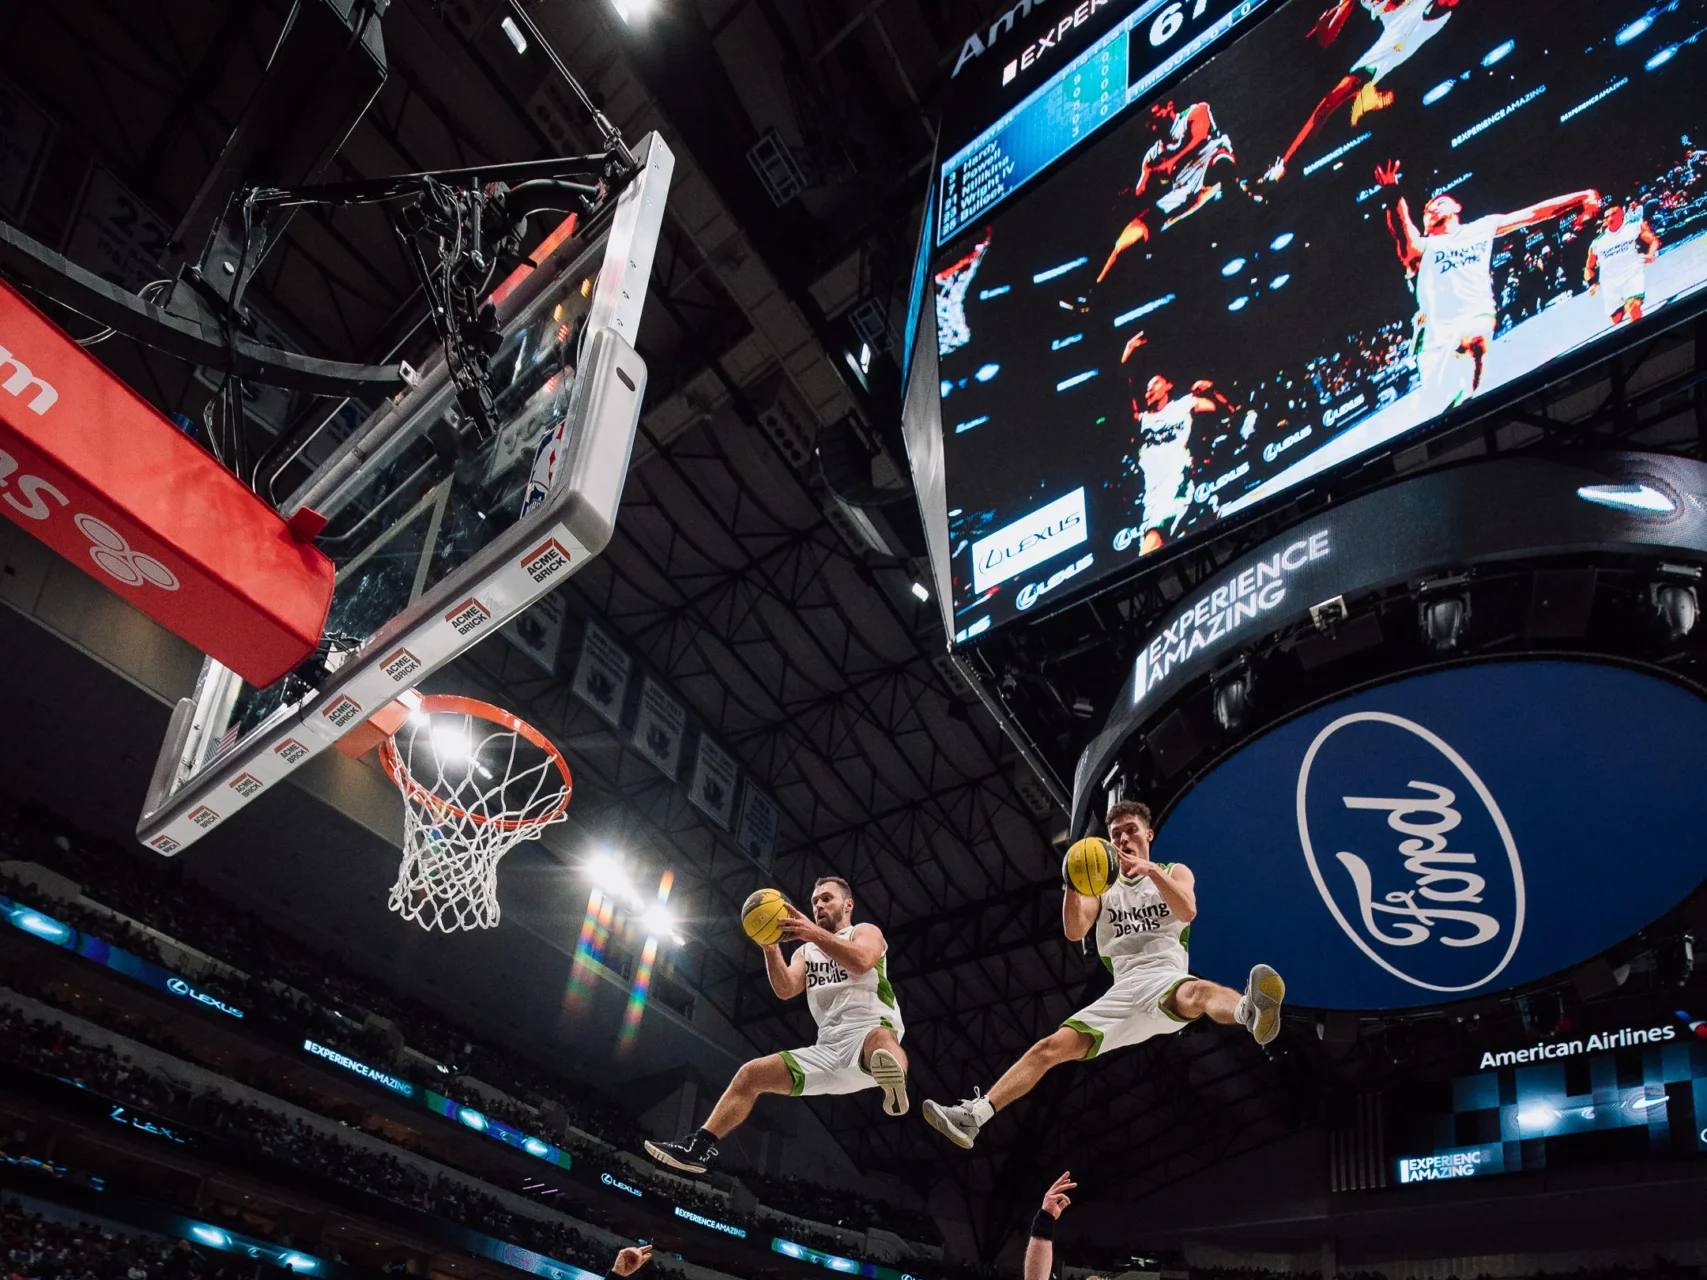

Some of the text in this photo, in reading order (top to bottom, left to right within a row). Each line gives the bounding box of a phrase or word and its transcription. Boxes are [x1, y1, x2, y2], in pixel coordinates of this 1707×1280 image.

[1456, 84, 1547, 145] EXPERIENCE AMAZING
[962, 148, 1001, 184] Powell
[963, 140, 998, 173] Hardy
[960, 174, 1000, 209] Wright
[1003, 161, 1015, 178] IV
[960, 184, 1004, 221] Bullock
[1006, 511, 1081, 558] LEXUS
[527, 549, 558, 576] ACME
[533, 557, 567, 584] BRICK
[1147, 530, 1329, 665] EXPERIENCE
[451, 606, 479, 629] ACME
[458, 614, 487, 635] BRICK
[1147, 579, 1287, 691] AMAZING
[385, 655, 410, 677] ACME
[392, 662, 418, 682] BRICK
[328, 702, 351, 722] ACME
[336, 708, 358, 727] BRICK
[280, 743, 299, 759] ACME
[287, 749, 306, 764] BRICK
[235, 778, 253, 793] ACME
[193, 810, 211, 825] ACME
[1335, 780, 1500, 948] Ford
[1108, 903, 1170, 923] Dunking
[1114, 918, 1160, 937] Devils
[808, 968, 848, 988] Devils
[189, 989, 244, 1018] LEXUS
[1480, 1025, 1675, 1069] American Airlines
[311, 1043, 413, 1095] EXPERIENCE AMAZING
[1409, 1165, 1474, 1182] AMAZING
[613, 1180, 643, 1197] LEXUS
[678, 1209, 747, 1238] EXPERIENCE AMAZING
